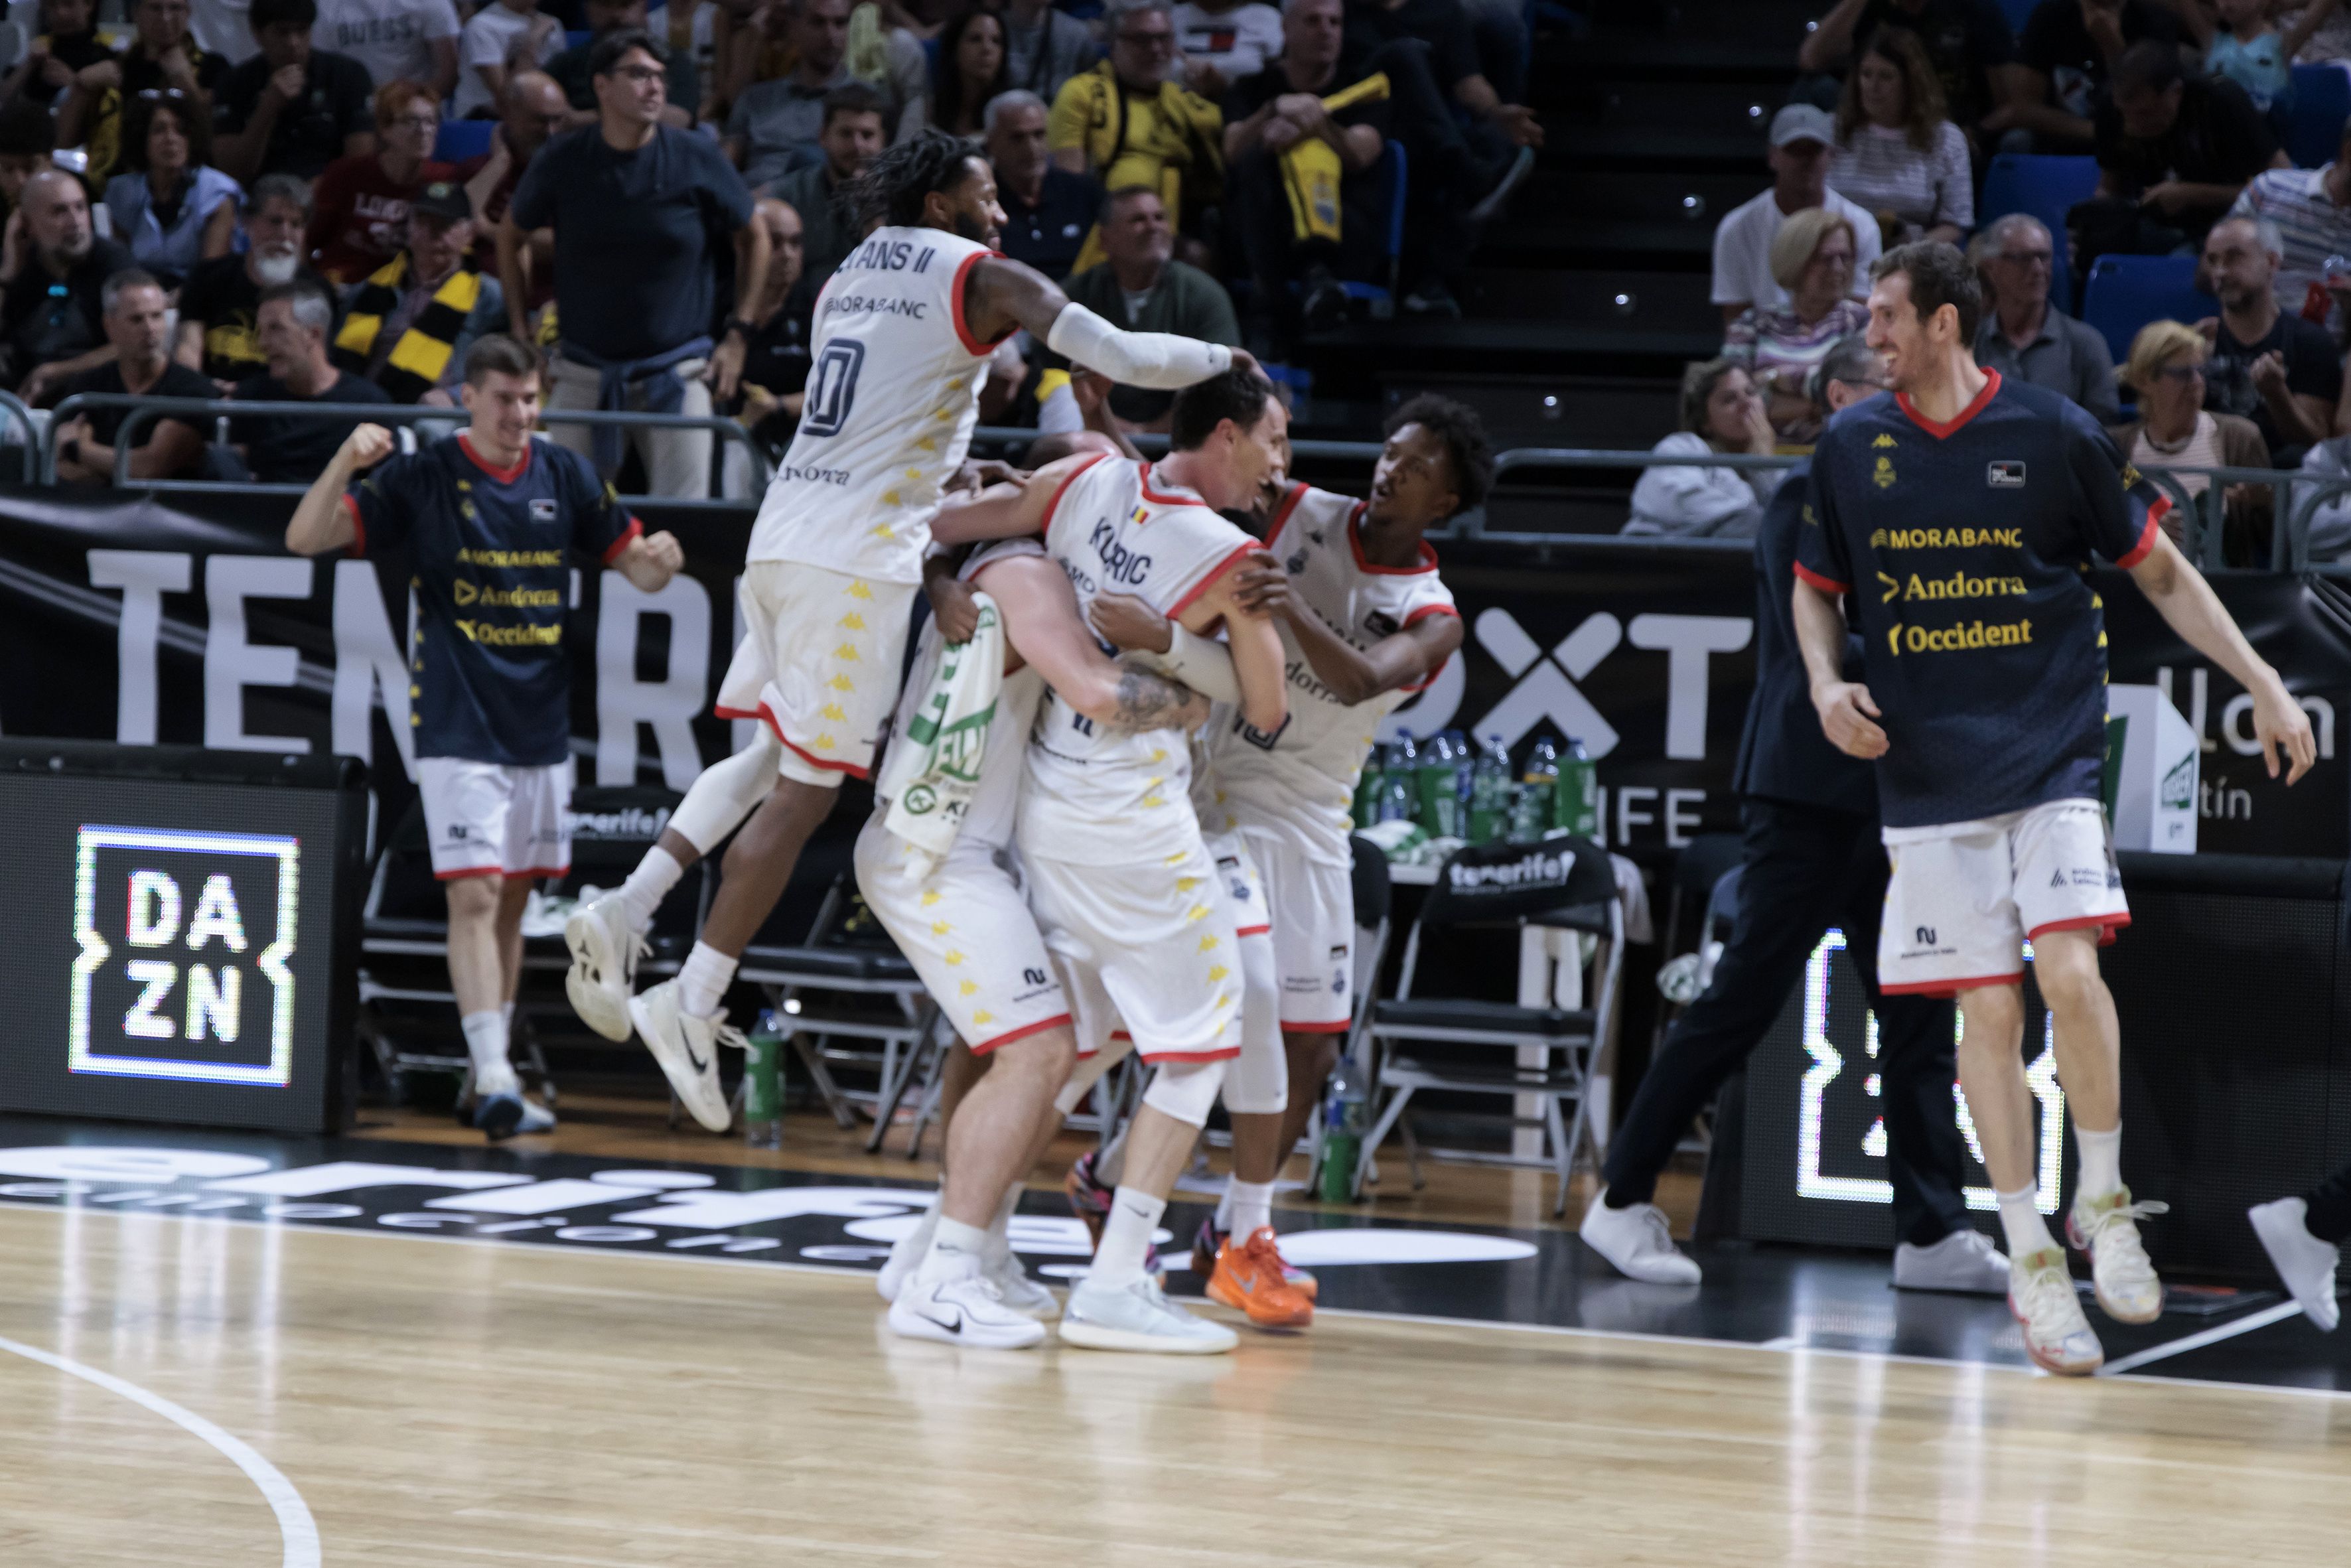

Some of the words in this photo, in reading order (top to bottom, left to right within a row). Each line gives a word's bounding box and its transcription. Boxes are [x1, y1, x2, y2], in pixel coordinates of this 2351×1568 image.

[1890, 528, 2023, 549] MORABANC
[1903, 570, 2029, 601] Andorra
[1906, 618, 2033, 653] Occident
